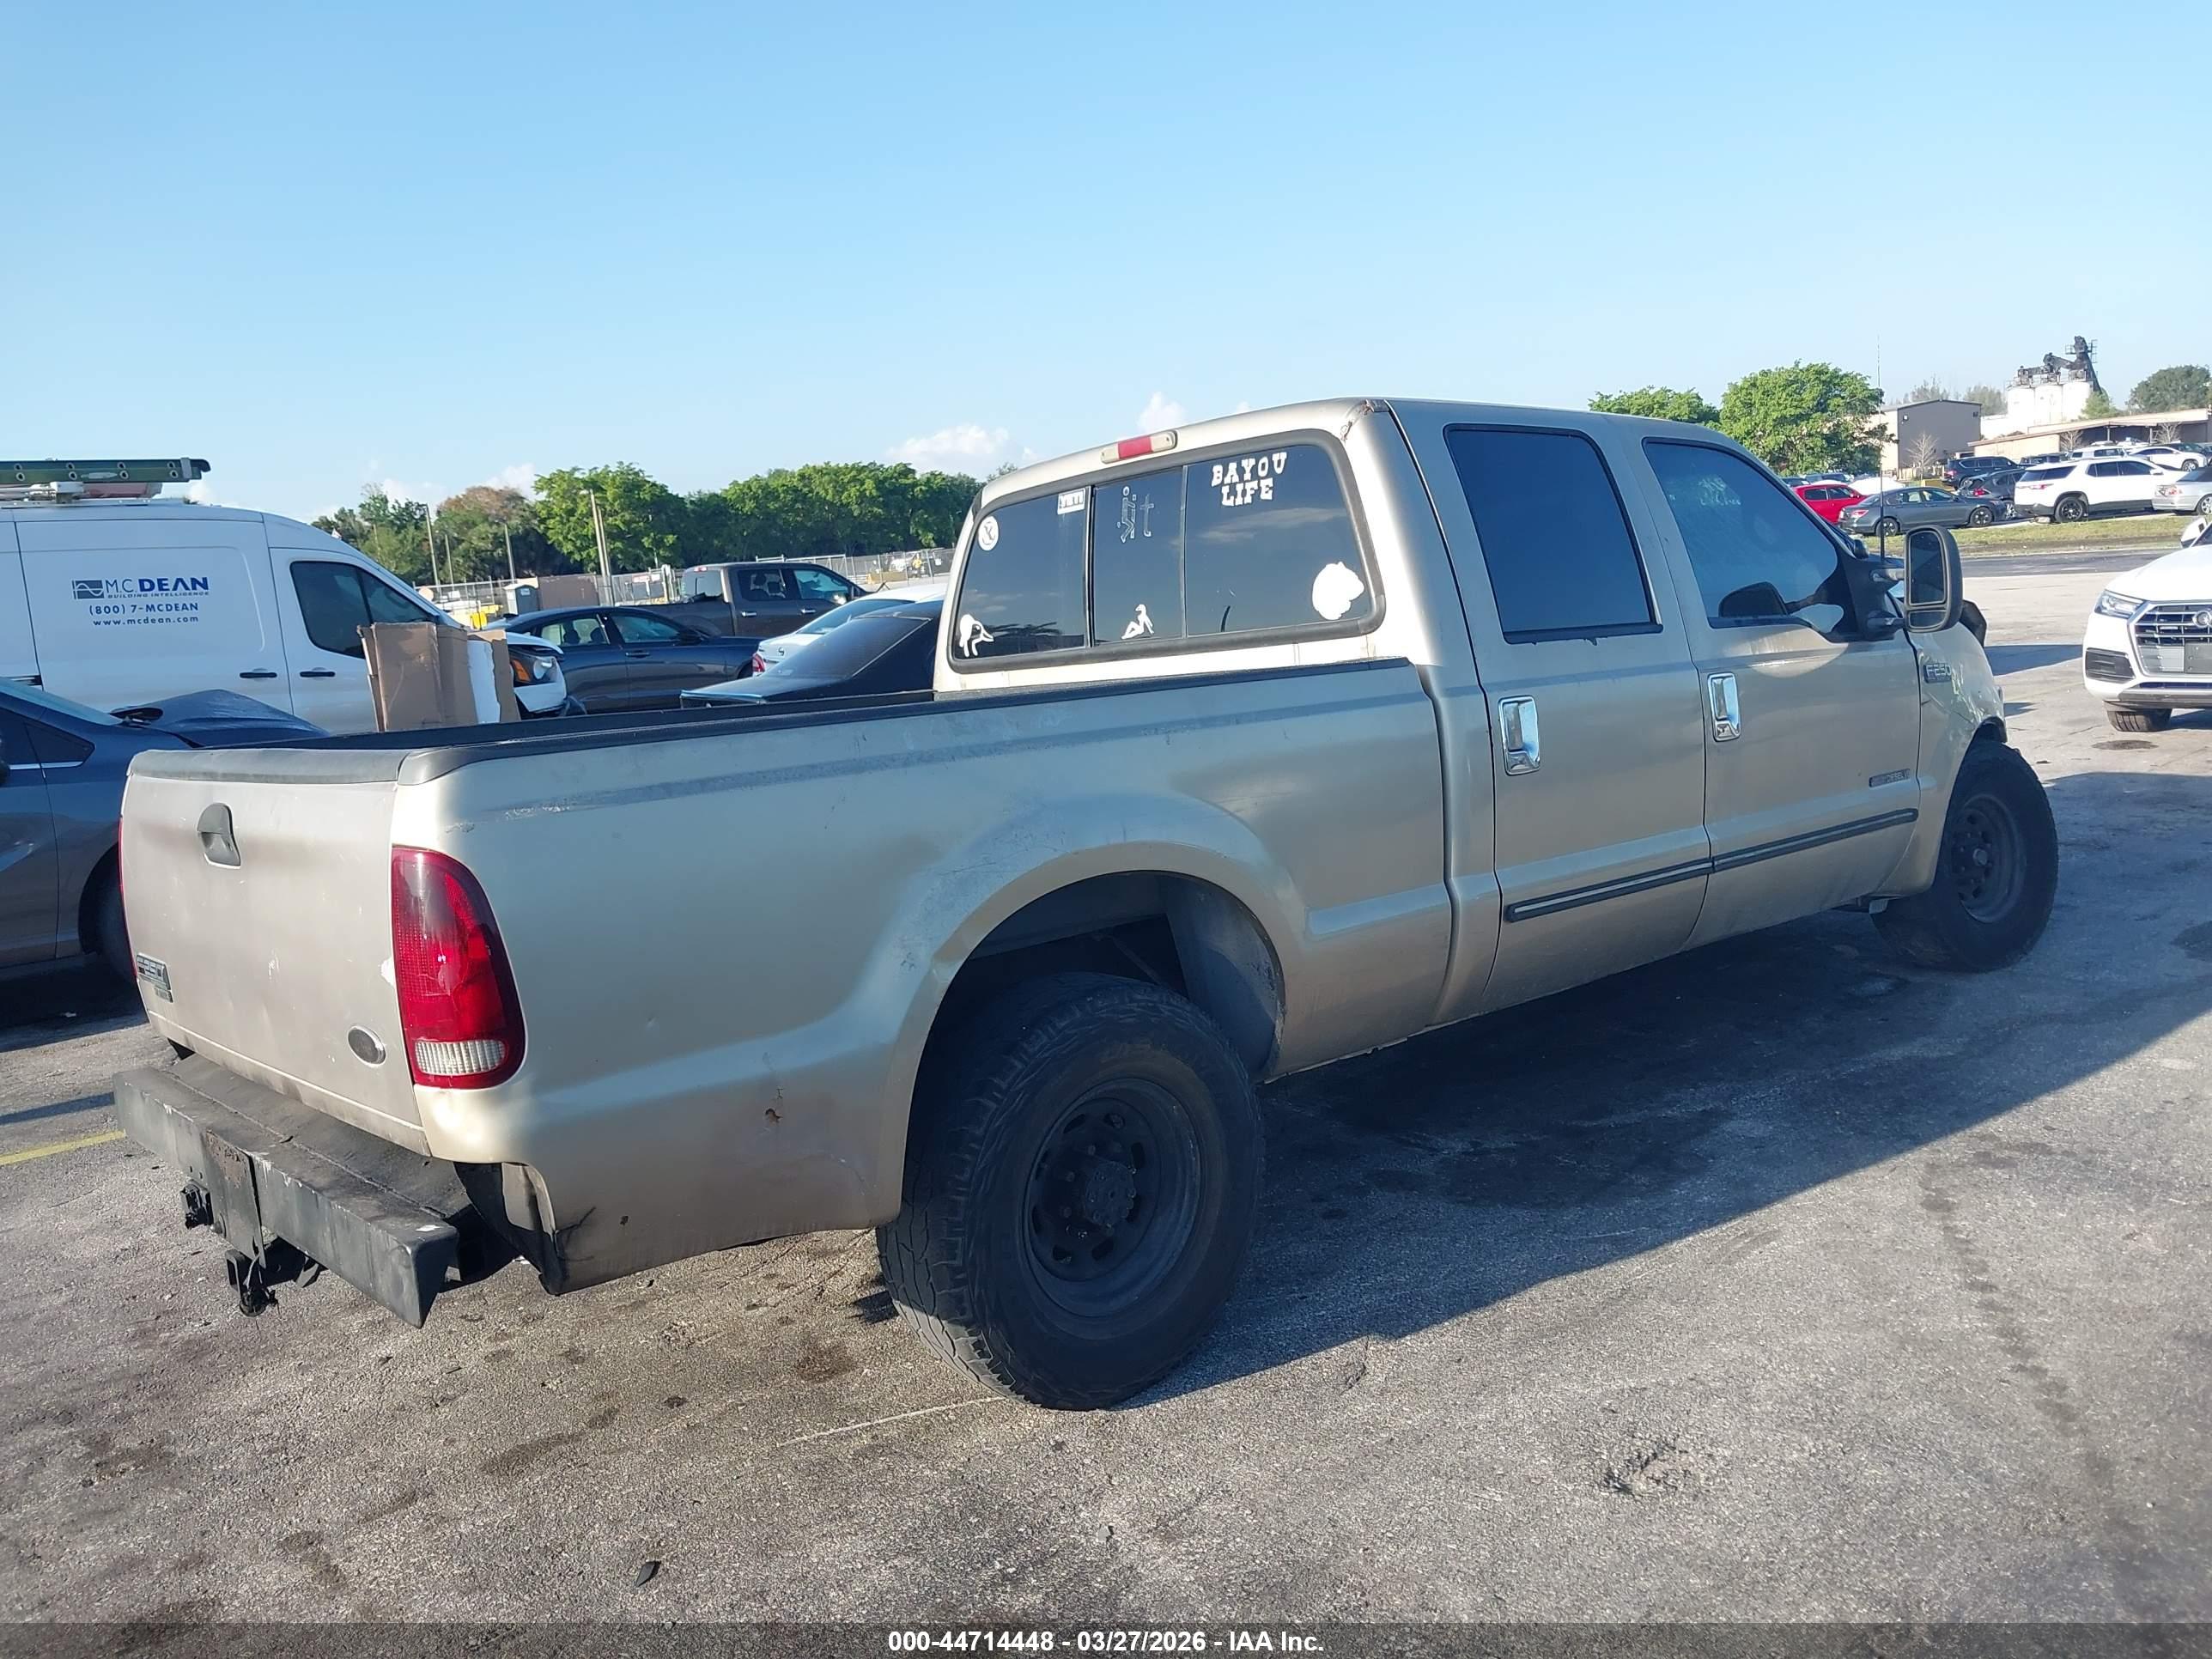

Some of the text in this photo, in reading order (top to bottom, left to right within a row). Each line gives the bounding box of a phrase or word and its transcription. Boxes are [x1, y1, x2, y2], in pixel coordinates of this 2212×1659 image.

[1211, 452, 1287, 488] BAYOU
[1221, 477, 1273, 507] LIFE
[138, 577, 210, 592] DEAN
[89, 602, 199, 616] (800) 7-MCDEAN
[93, 616, 199, 626] www.mcdean.com
